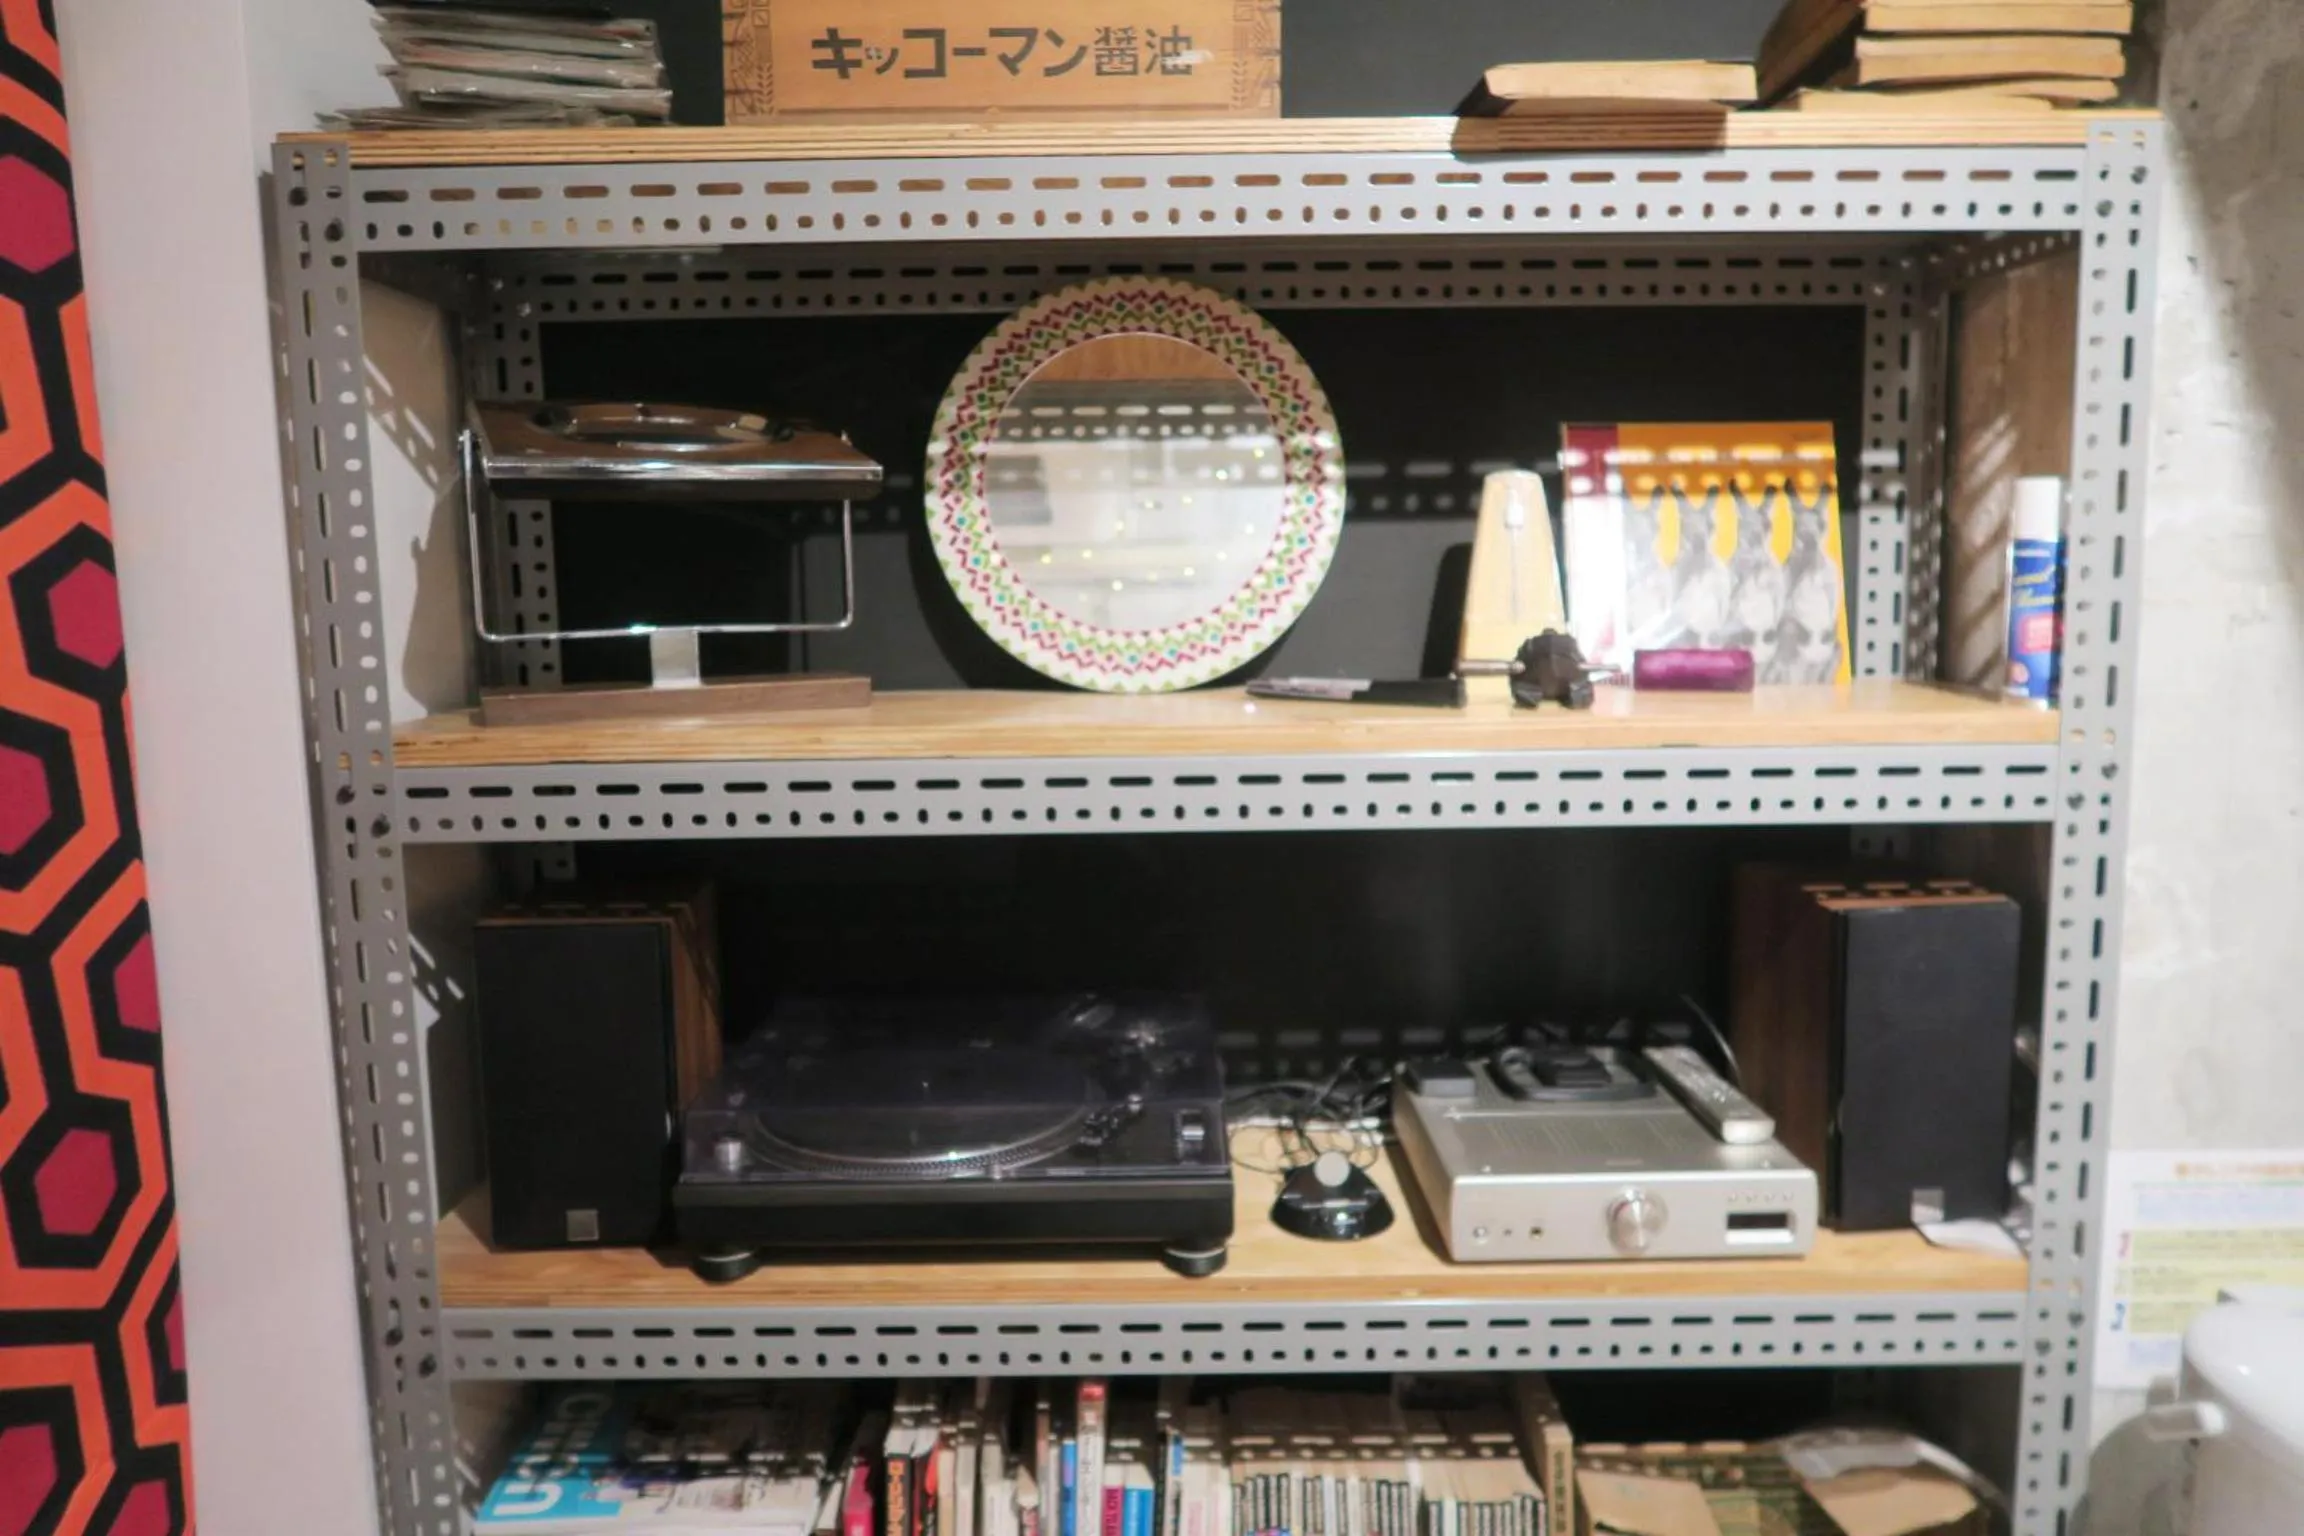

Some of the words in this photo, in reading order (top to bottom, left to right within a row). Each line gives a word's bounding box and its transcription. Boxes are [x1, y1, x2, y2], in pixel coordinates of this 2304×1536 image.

[811, 25, 1193, 79] キッコーマン醤油
